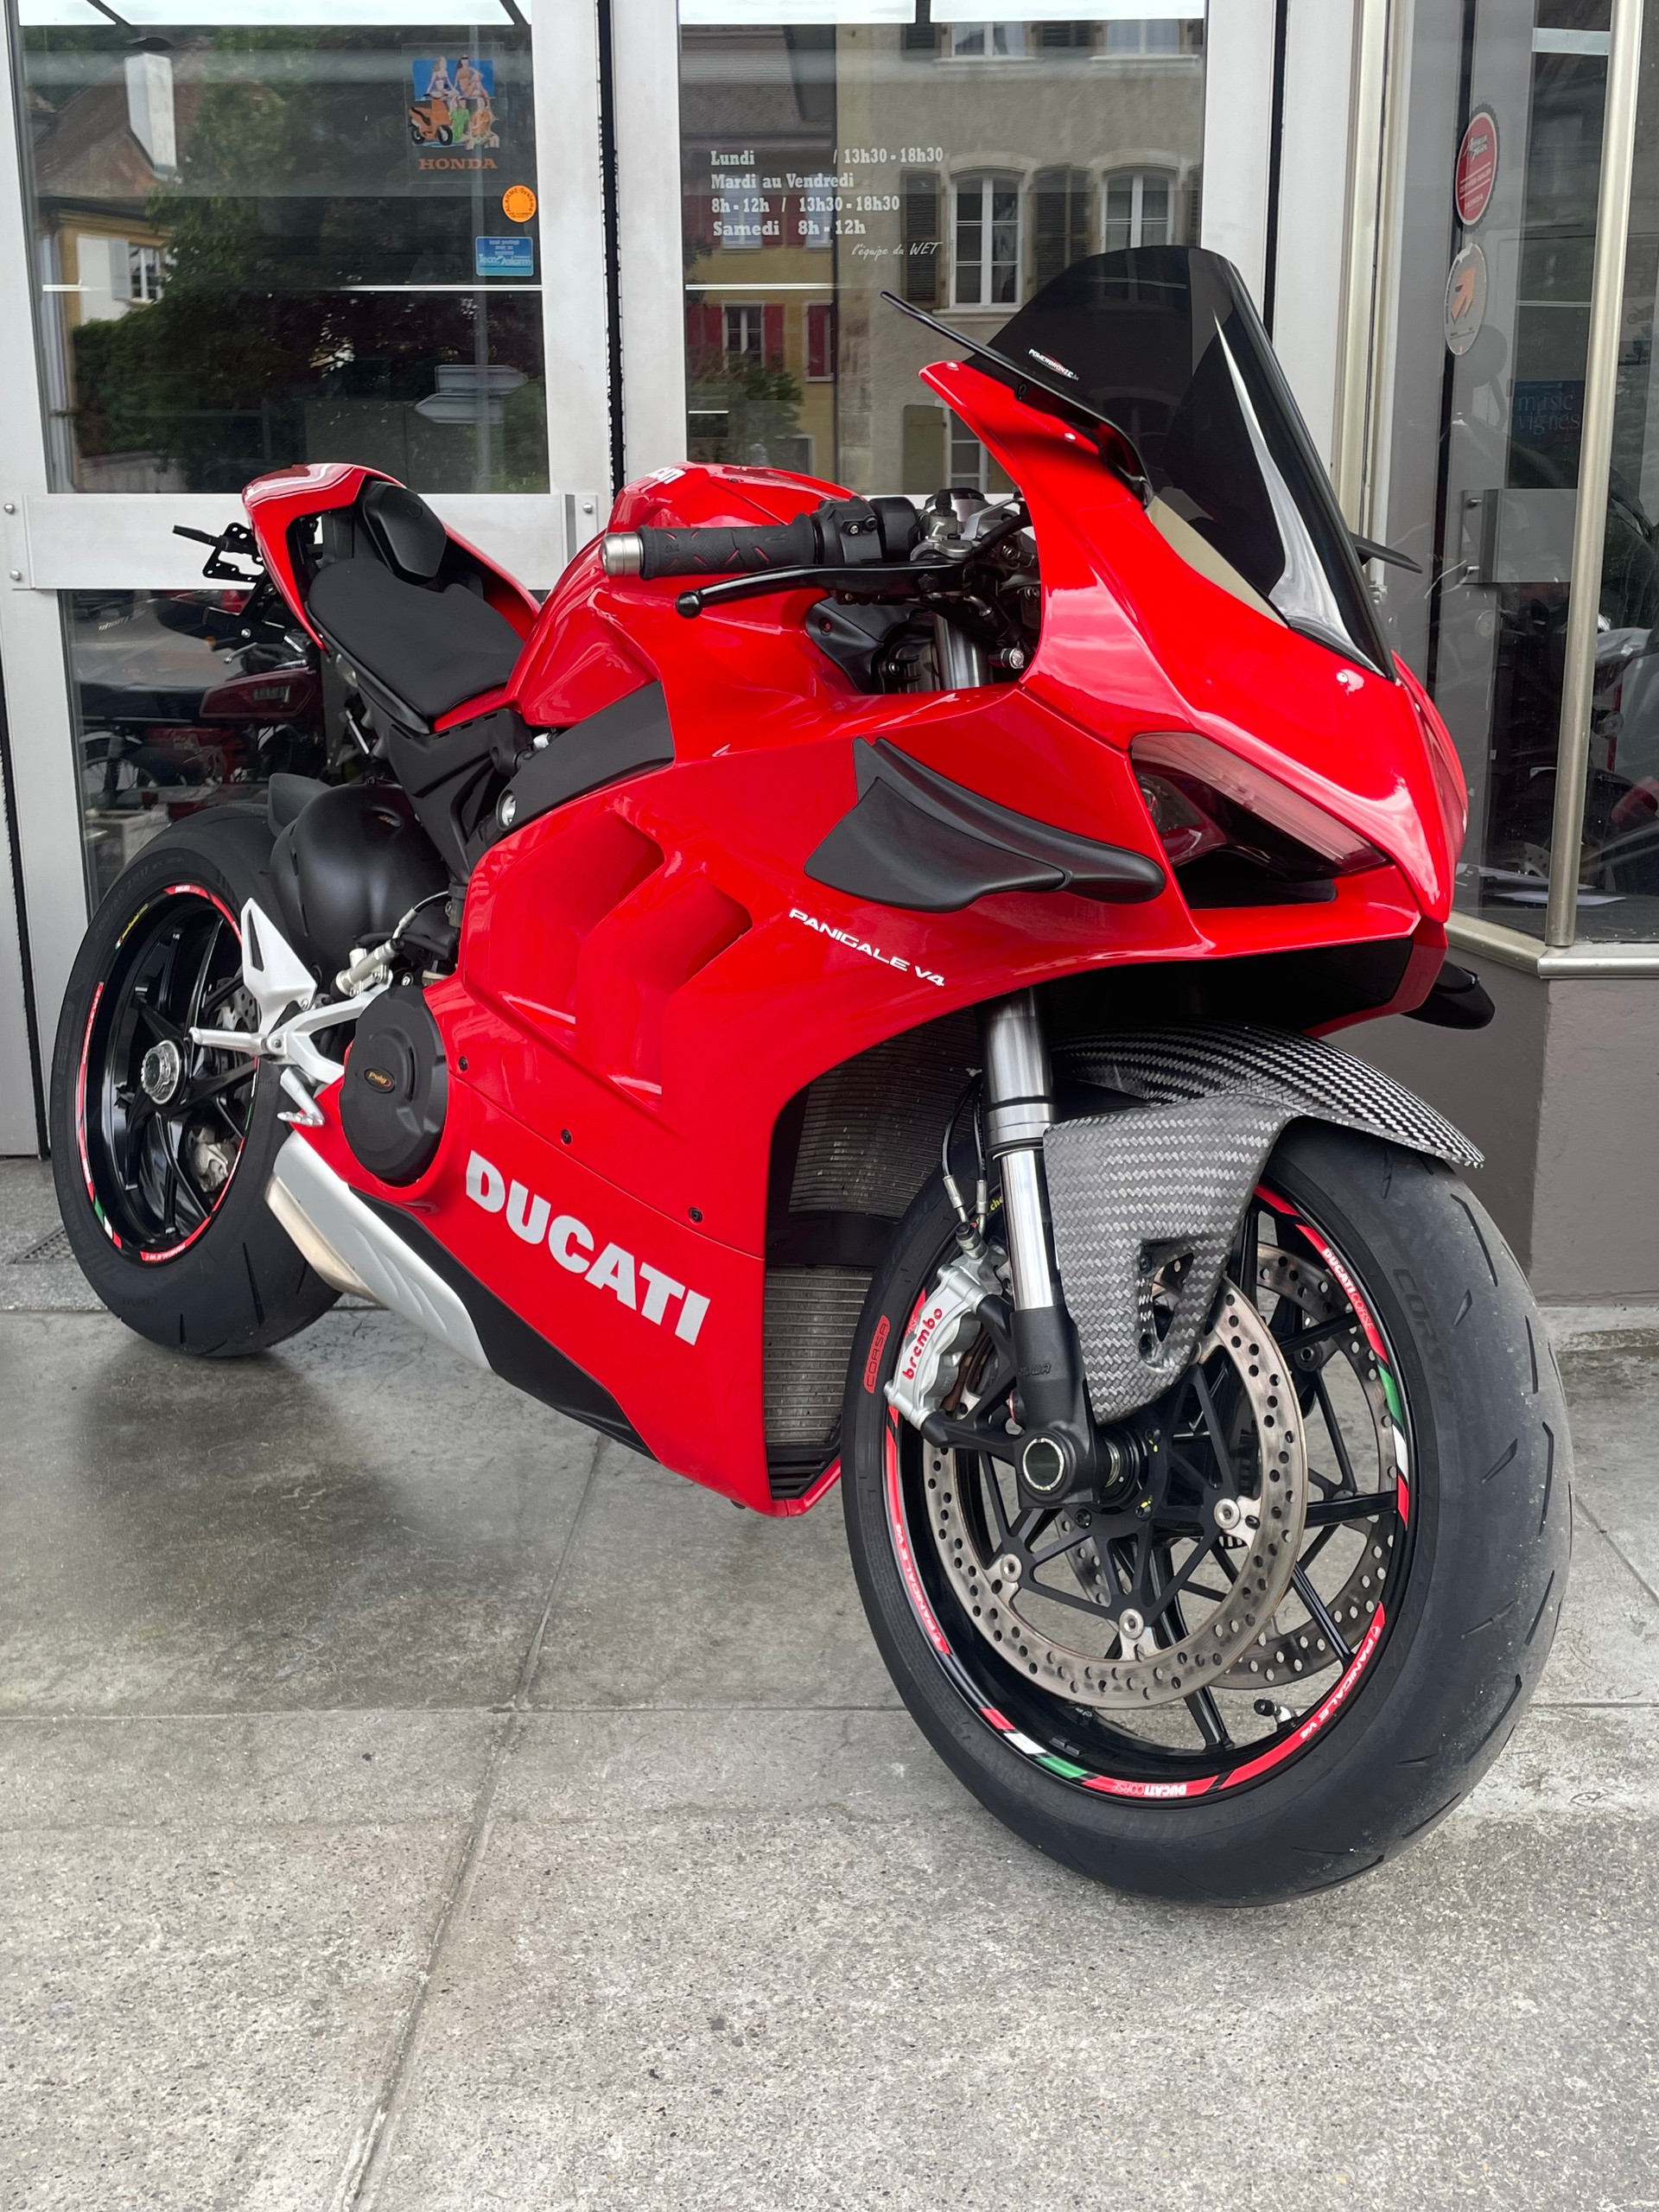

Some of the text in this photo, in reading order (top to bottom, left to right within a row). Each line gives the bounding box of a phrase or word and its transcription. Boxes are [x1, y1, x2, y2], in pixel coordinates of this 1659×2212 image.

[418, 158, 499, 170] HONDA
[710, 149, 755, 166] Lundi
[843, 147, 887, 164] 13h30
[899, 146, 944, 163] 18h30
[710, 172, 855, 189] Mardi au Vendredi
[711, 197, 730, 213] 8h
[742, 197, 770, 213] 12h
[798, 196, 843, 213] 13h30
[855, 195, 900, 212] 18h30
[712, 220, 779, 237] Samedi
[798, 219, 820, 236] 8h
[835, 219, 866, 235] 12h
[893, 244, 904, 256] du
[909, 242, 944, 256] WET
[789, 908, 945, 987] PANIGALE V4
[466, 1149, 711, 1346] DUCATI
[901, 1307, 944, 1381] brembo
[867, 1322, 888, 1387] CORSA
[1299, 1637, 1375, 1739] PANIGALE V4
[1144, 1783, 1187, 1798] DUCATI
